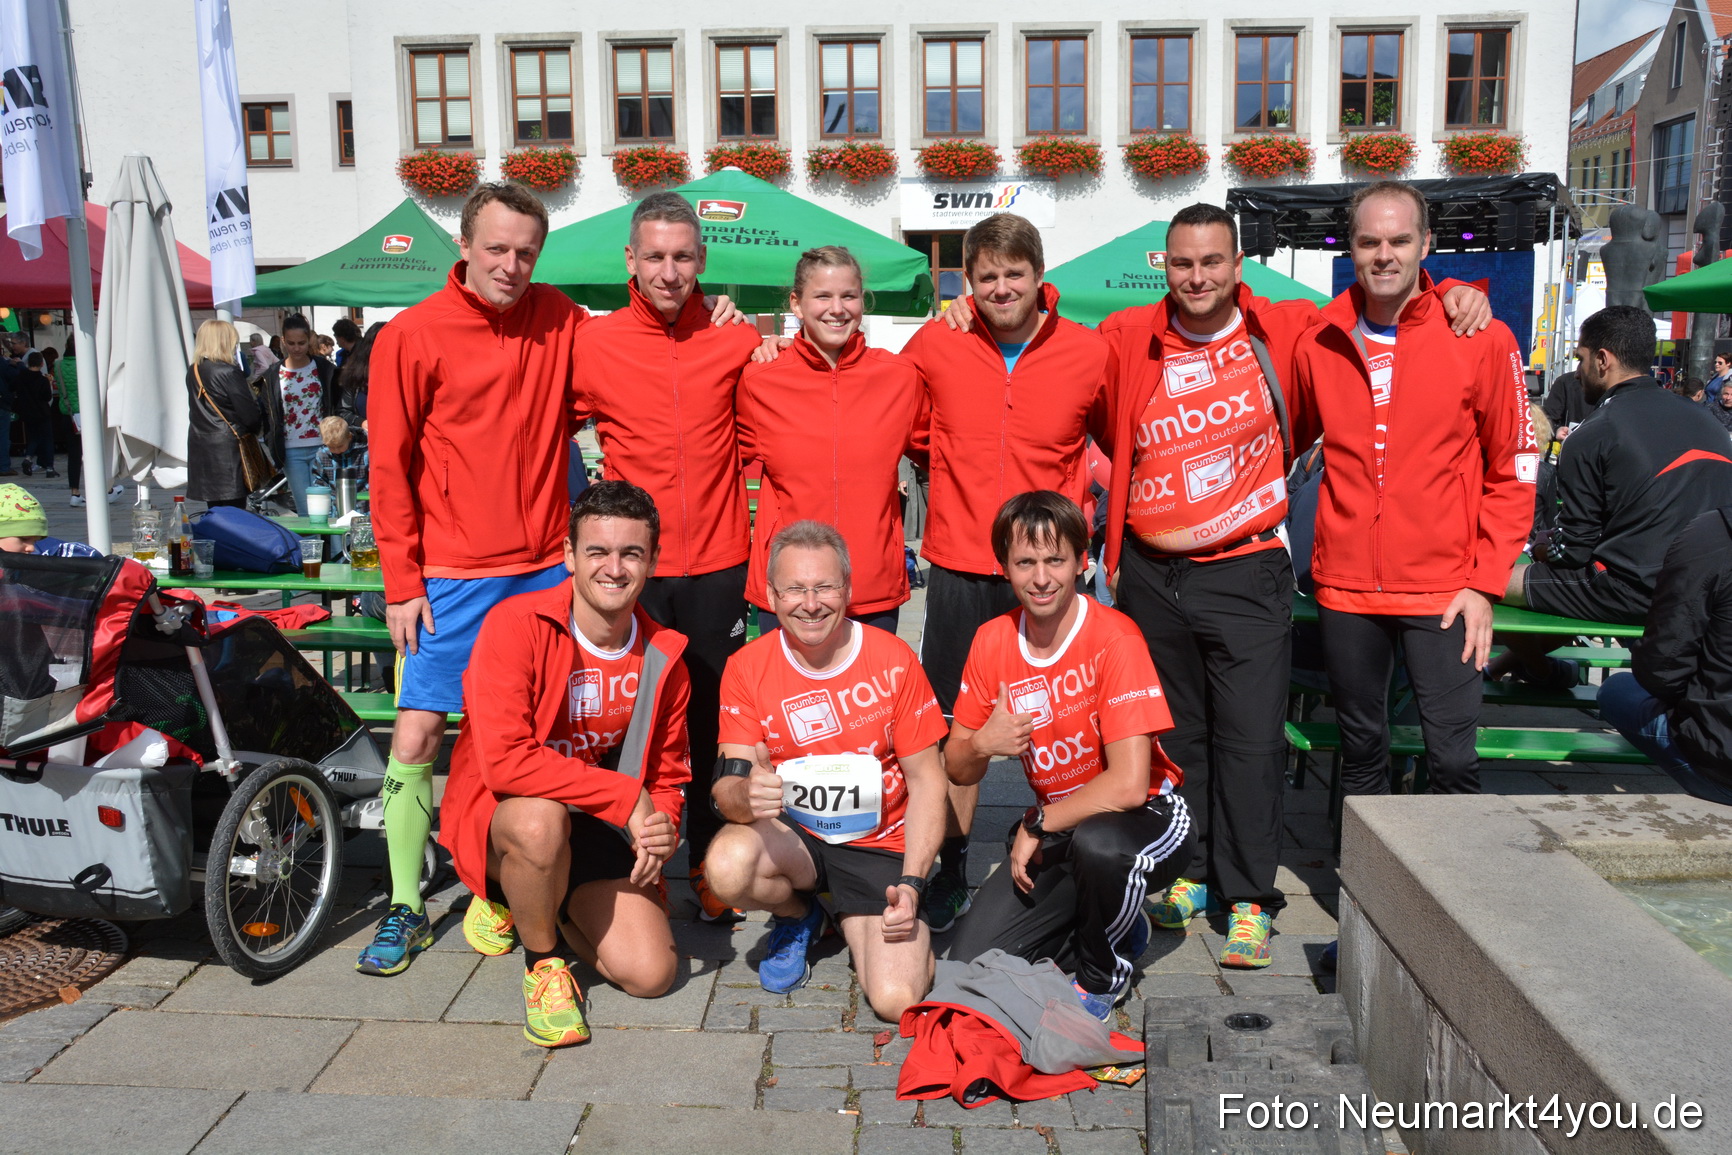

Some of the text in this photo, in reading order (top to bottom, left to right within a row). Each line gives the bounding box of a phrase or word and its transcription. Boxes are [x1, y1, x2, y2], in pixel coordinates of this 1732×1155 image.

[933, 192, 993, 209] swn
[340, 262, 437, 273] Lammsbräu
[357, 256, 428, 265] Neumarkter
[1158, 439, 1202, 457] wohnen
[1211, 416, 1258, 441] outdoor
[1186, 449, 1230, 470] raumbox
[1140, 502, 1177, 516] outdoor
[1193, 498, 1256, 541] raumbox
[786, 694, 827, 712] raumbox
[1108, 688, 1148, 706] raumbox
[1061, 756, 1100, 781] outdoor
[792, 785, 860, 812] 2071
[0, 813, 72, 838] THULE
[816, 819, 842, 830] Hans
